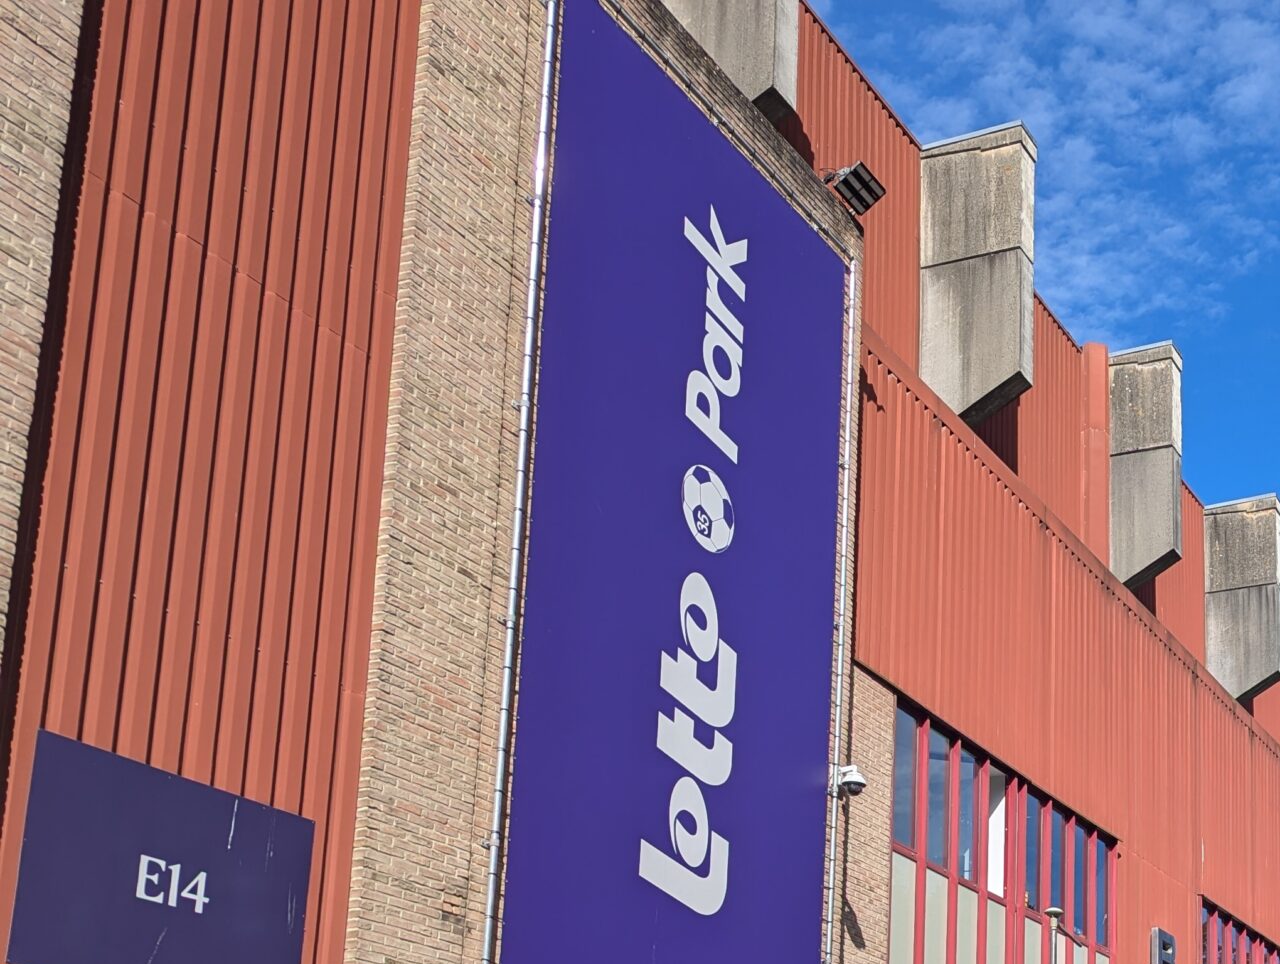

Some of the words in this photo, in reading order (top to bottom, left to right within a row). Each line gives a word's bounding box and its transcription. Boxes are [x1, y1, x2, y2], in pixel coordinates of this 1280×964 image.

[683, 205, 748, 464] Park
[639, 572, 738, 916] Lotto
[136, 854, 210, 914] E14
